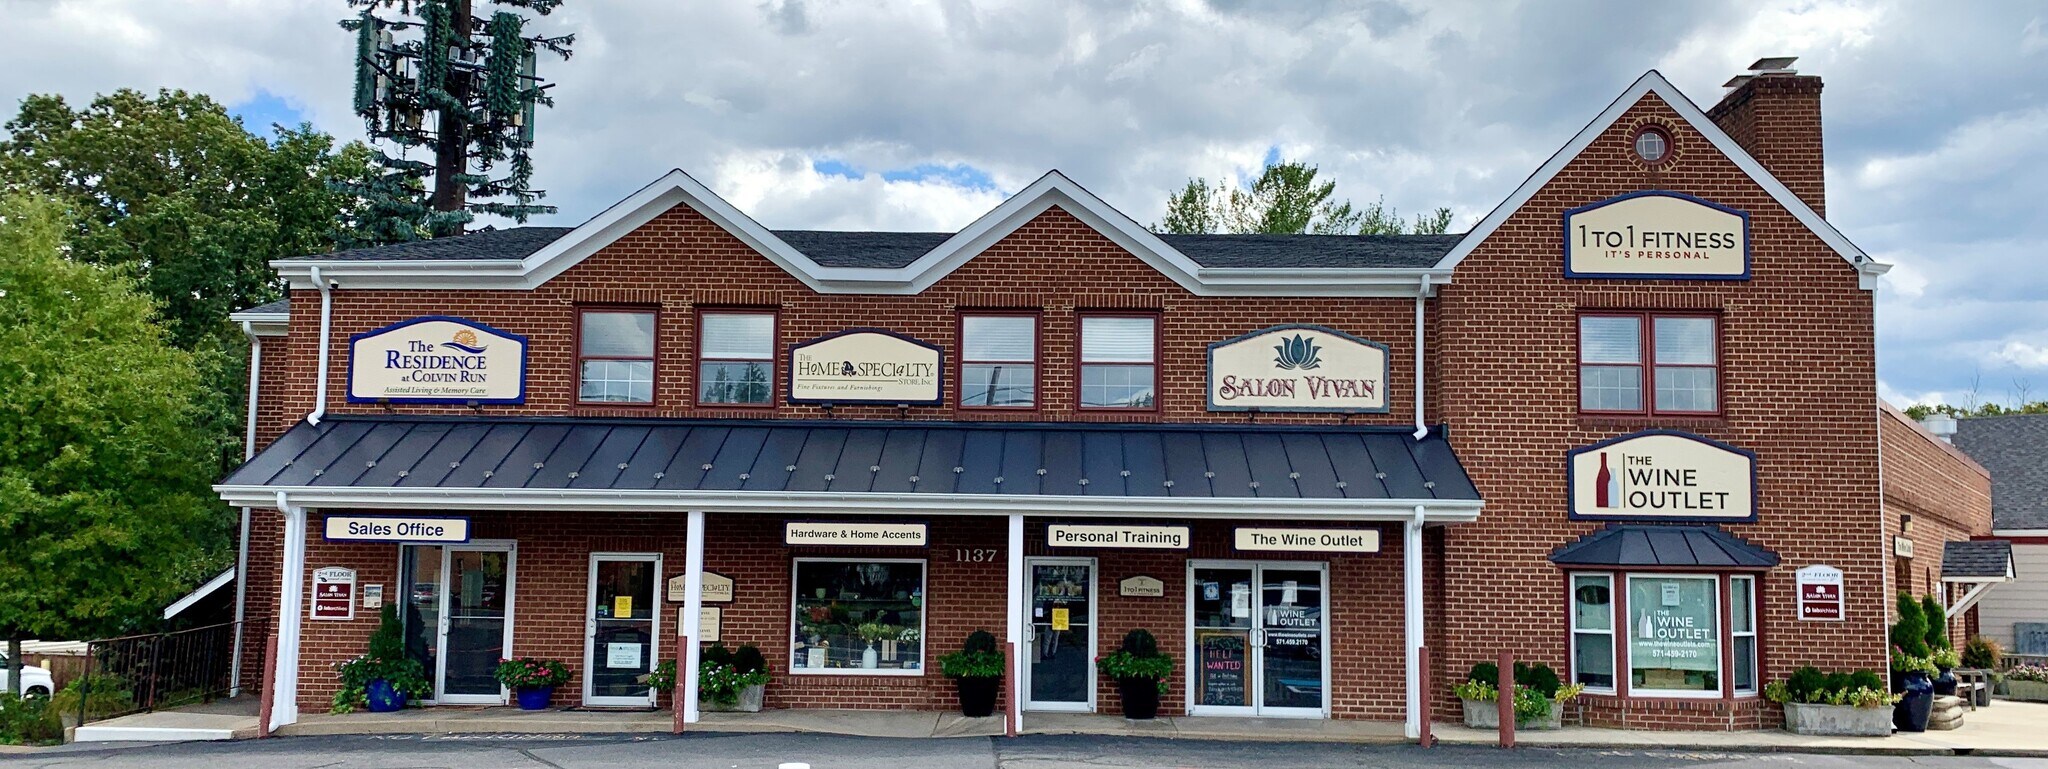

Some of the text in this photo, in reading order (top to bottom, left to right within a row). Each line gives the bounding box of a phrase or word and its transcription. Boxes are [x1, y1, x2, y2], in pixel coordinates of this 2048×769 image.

[1642, 232, 1735, 248] FITNESS
[1638, 251, 1709, 259] PERSONAL
[408, 340, 434, 352] The
[385, 350, 486, 370] RESIDENCE
[412, 370, 456, 382] COLVIN
[460, 372, 486, 382] RUN
[411, 386, 432, 395] Living
[442, 388, 468, 396] Memory
[1219, 375, 1376, 400] SALON VIVAN
[1628, 456, 1652, 465] THE
[1628, 469, 1696, 486] WINE
[1629, 491, 1729, 509] OUTLET
[349, 522, 444, 536] Sales Office
[790, 529, 921, 539] Hardware & Home Accents
[1056, 530, 1180, 546] Personal Training
[1251, 534, 1363, 547] The Wine Outlet
[956, 549, 997, 562] 1137
[1657, 617, 1693, 627] WINE
[1657, 628, 1710, 639] OUTLET
[1652, 650, 1697, 658] 571-459-2170
[1207, 661, 1240, 670] WANTED
